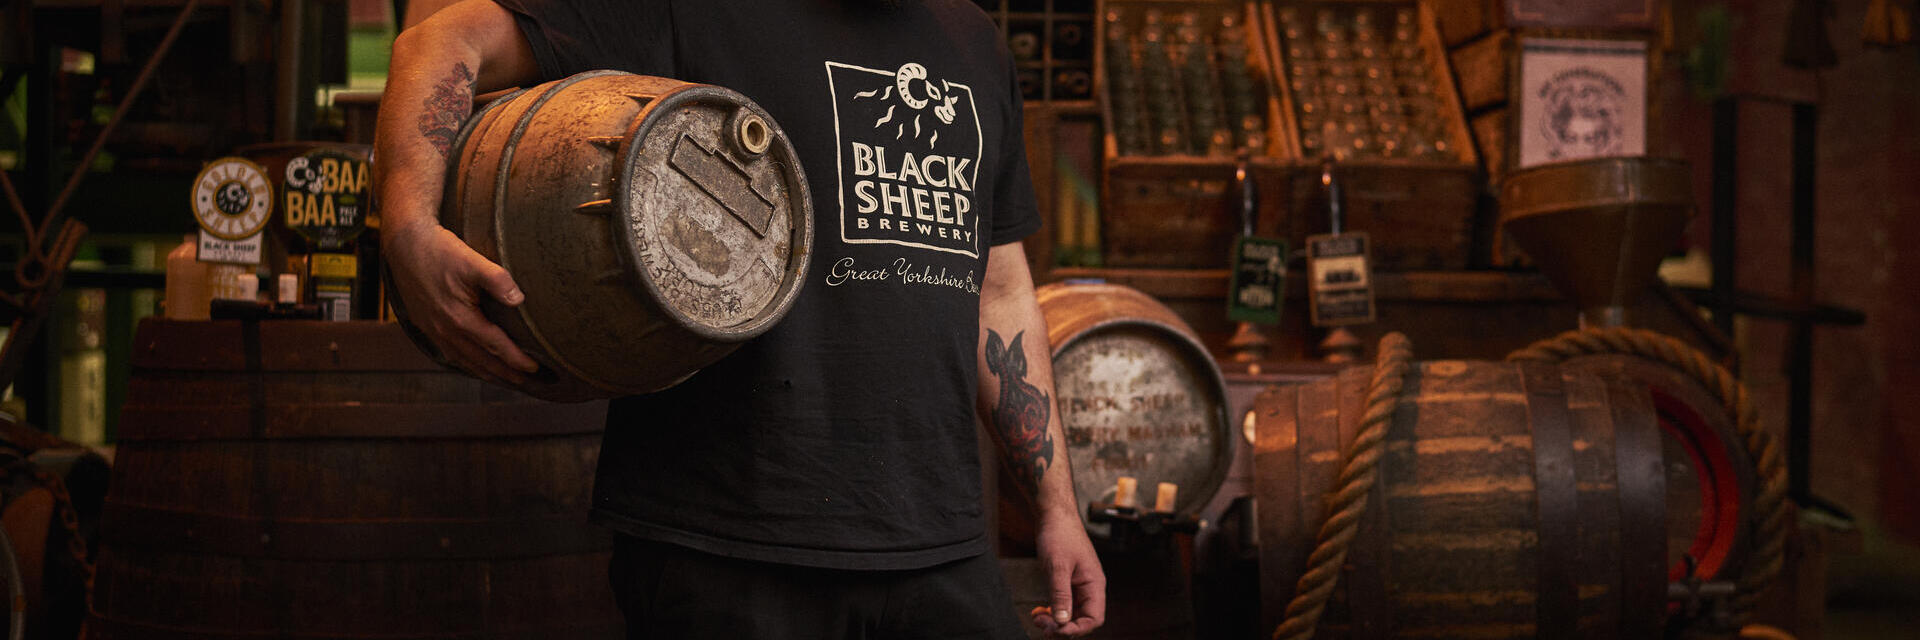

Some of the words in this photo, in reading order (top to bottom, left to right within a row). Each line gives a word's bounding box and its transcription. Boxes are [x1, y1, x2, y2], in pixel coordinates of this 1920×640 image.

[322, 158, 369, 193] BAA
[852, 142, 972, 192] BLACK
[288, 191, 337, 226] BAA
[854, 180, 971, 226] SHEEP
[857, 217, 972, 242] BREWERY
[826, 258, 889, 286] Great
[894, 258, 965, 289] Yorkshire
